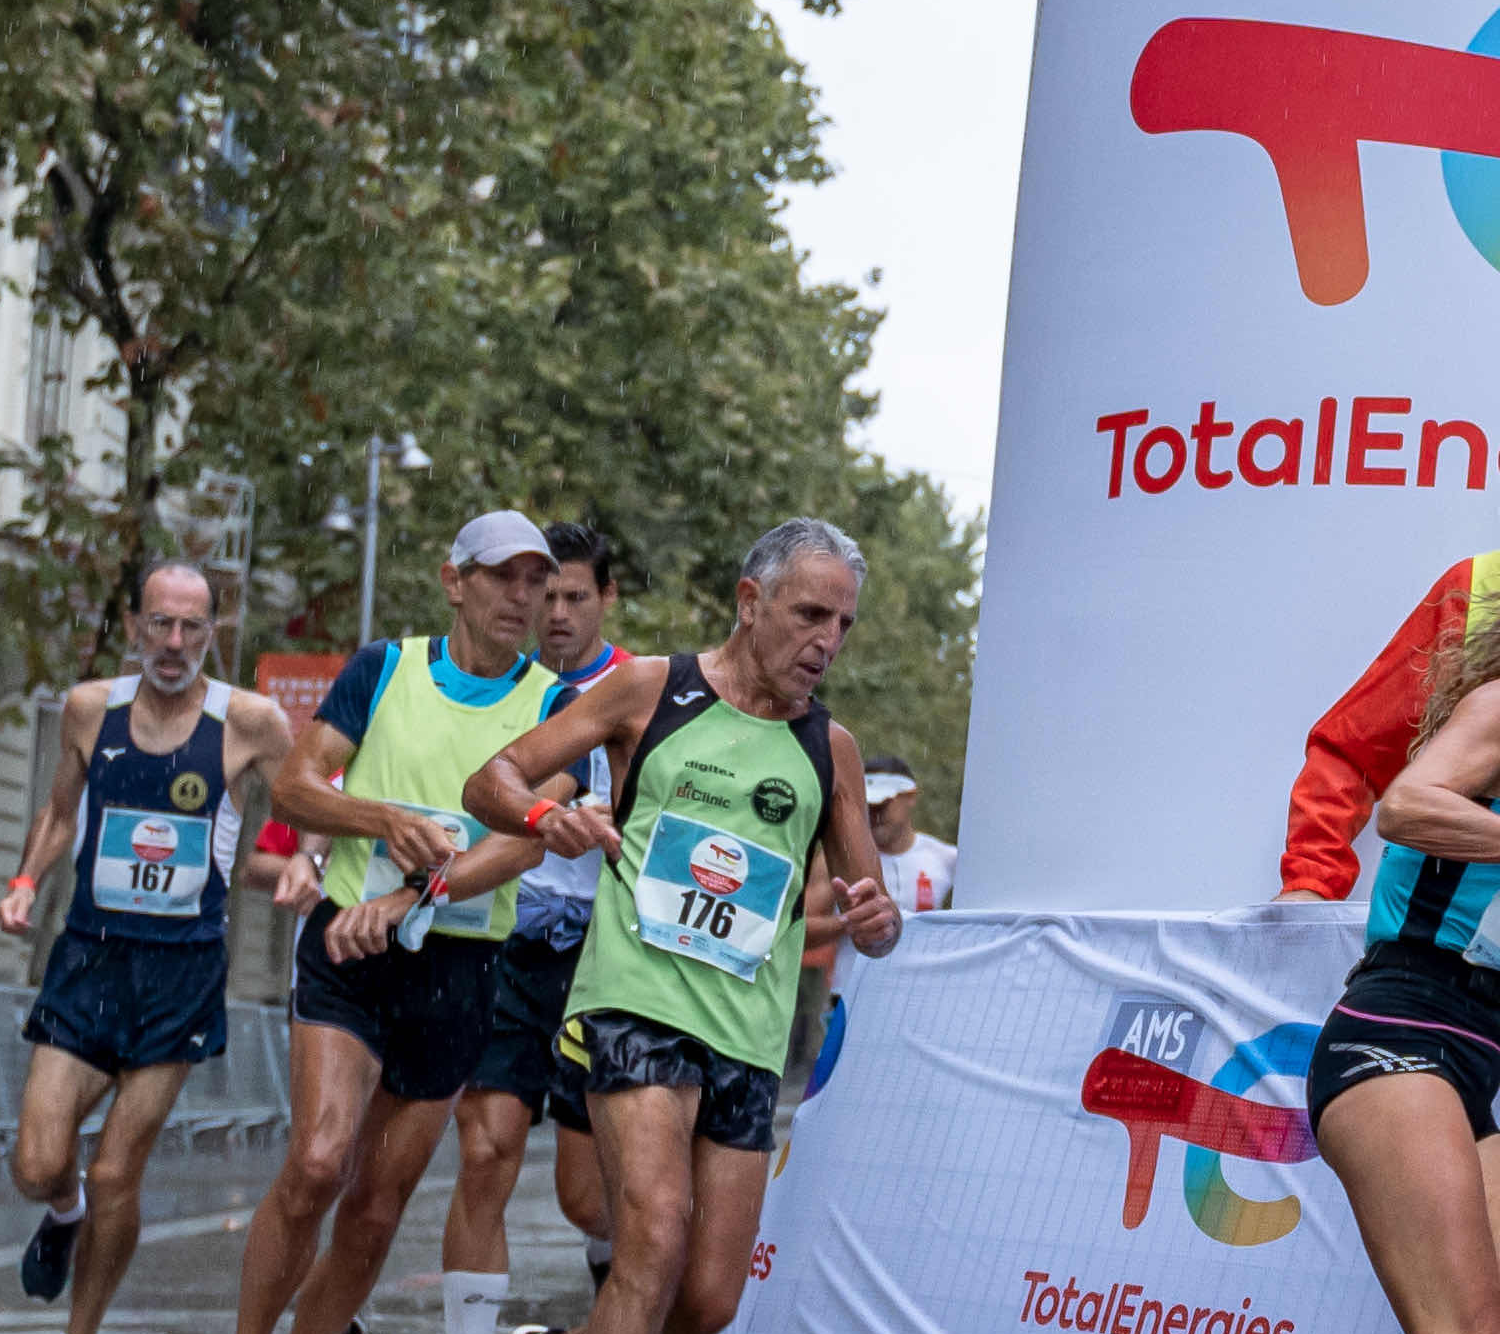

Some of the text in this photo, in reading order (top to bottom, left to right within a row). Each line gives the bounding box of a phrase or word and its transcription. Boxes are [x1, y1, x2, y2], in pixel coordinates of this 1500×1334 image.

[129, 863, 175, 894] 167
[677, 889, 737, 940] 176
[1120, 1009, 1194, 1060] AMS
